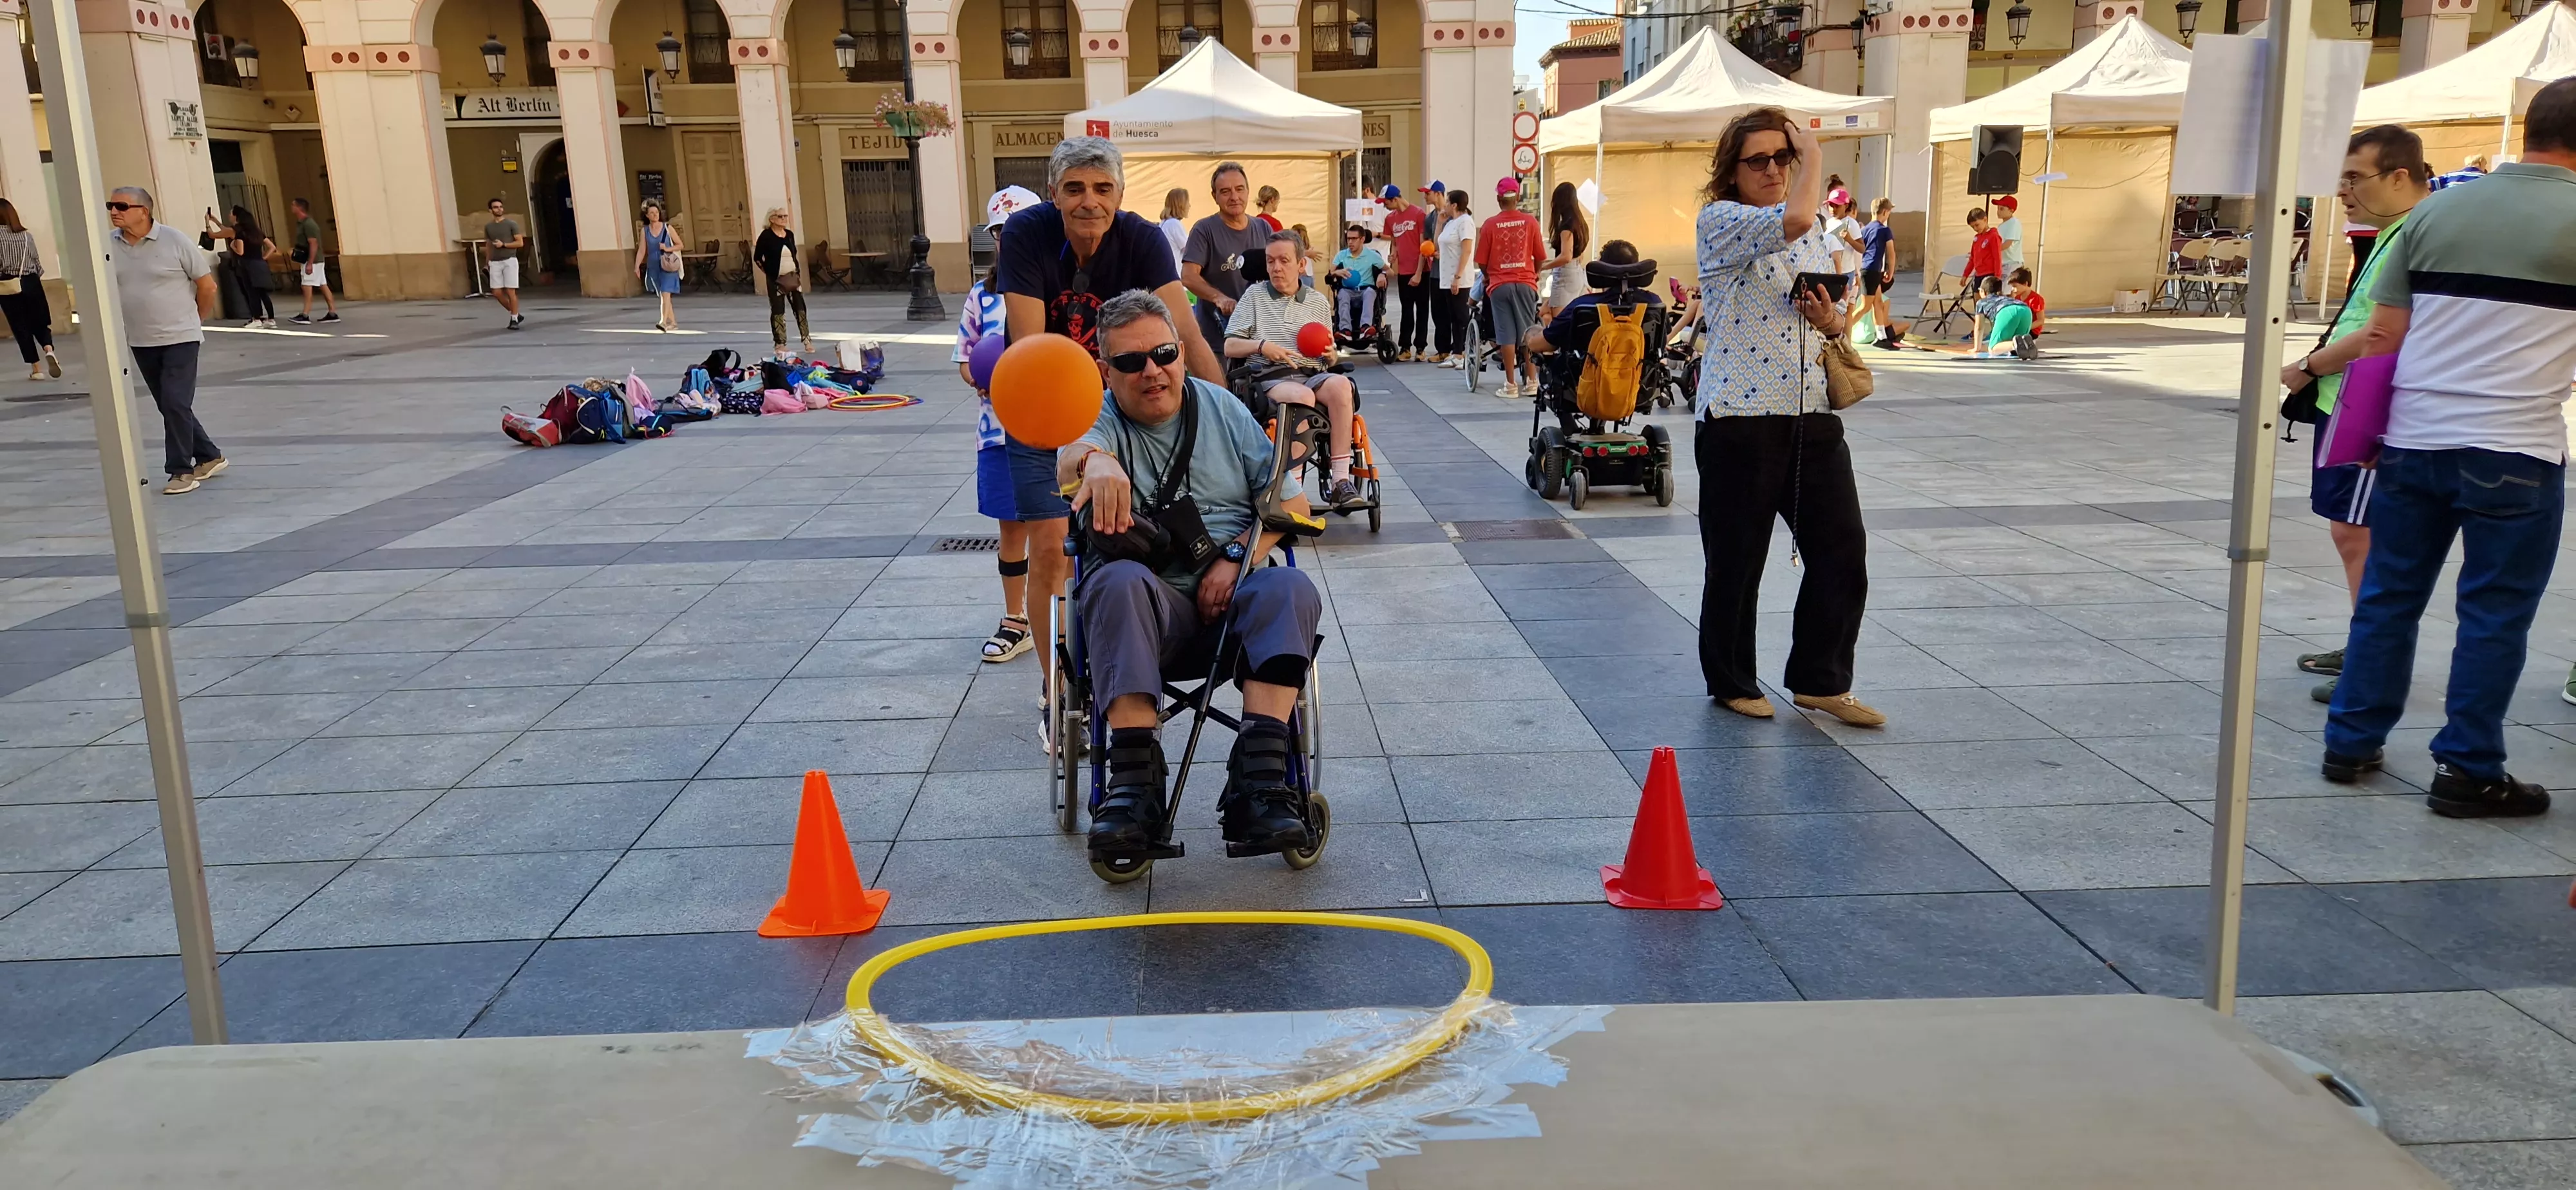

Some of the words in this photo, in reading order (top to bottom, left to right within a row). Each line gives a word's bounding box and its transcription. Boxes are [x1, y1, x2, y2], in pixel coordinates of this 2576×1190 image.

[478, 98, 501, 113] Alt
[505, 97, 551, 112] Berlin
[1113, 120, 1173, 129] Ayuntamiento
[996, 132, 1065, 146] ALMACEN
[1126, 129, 1159, 138] Huesca
[848, 135, 903, 149] TEJID
[1496, 220, 1526, 228] TAPESTRY
